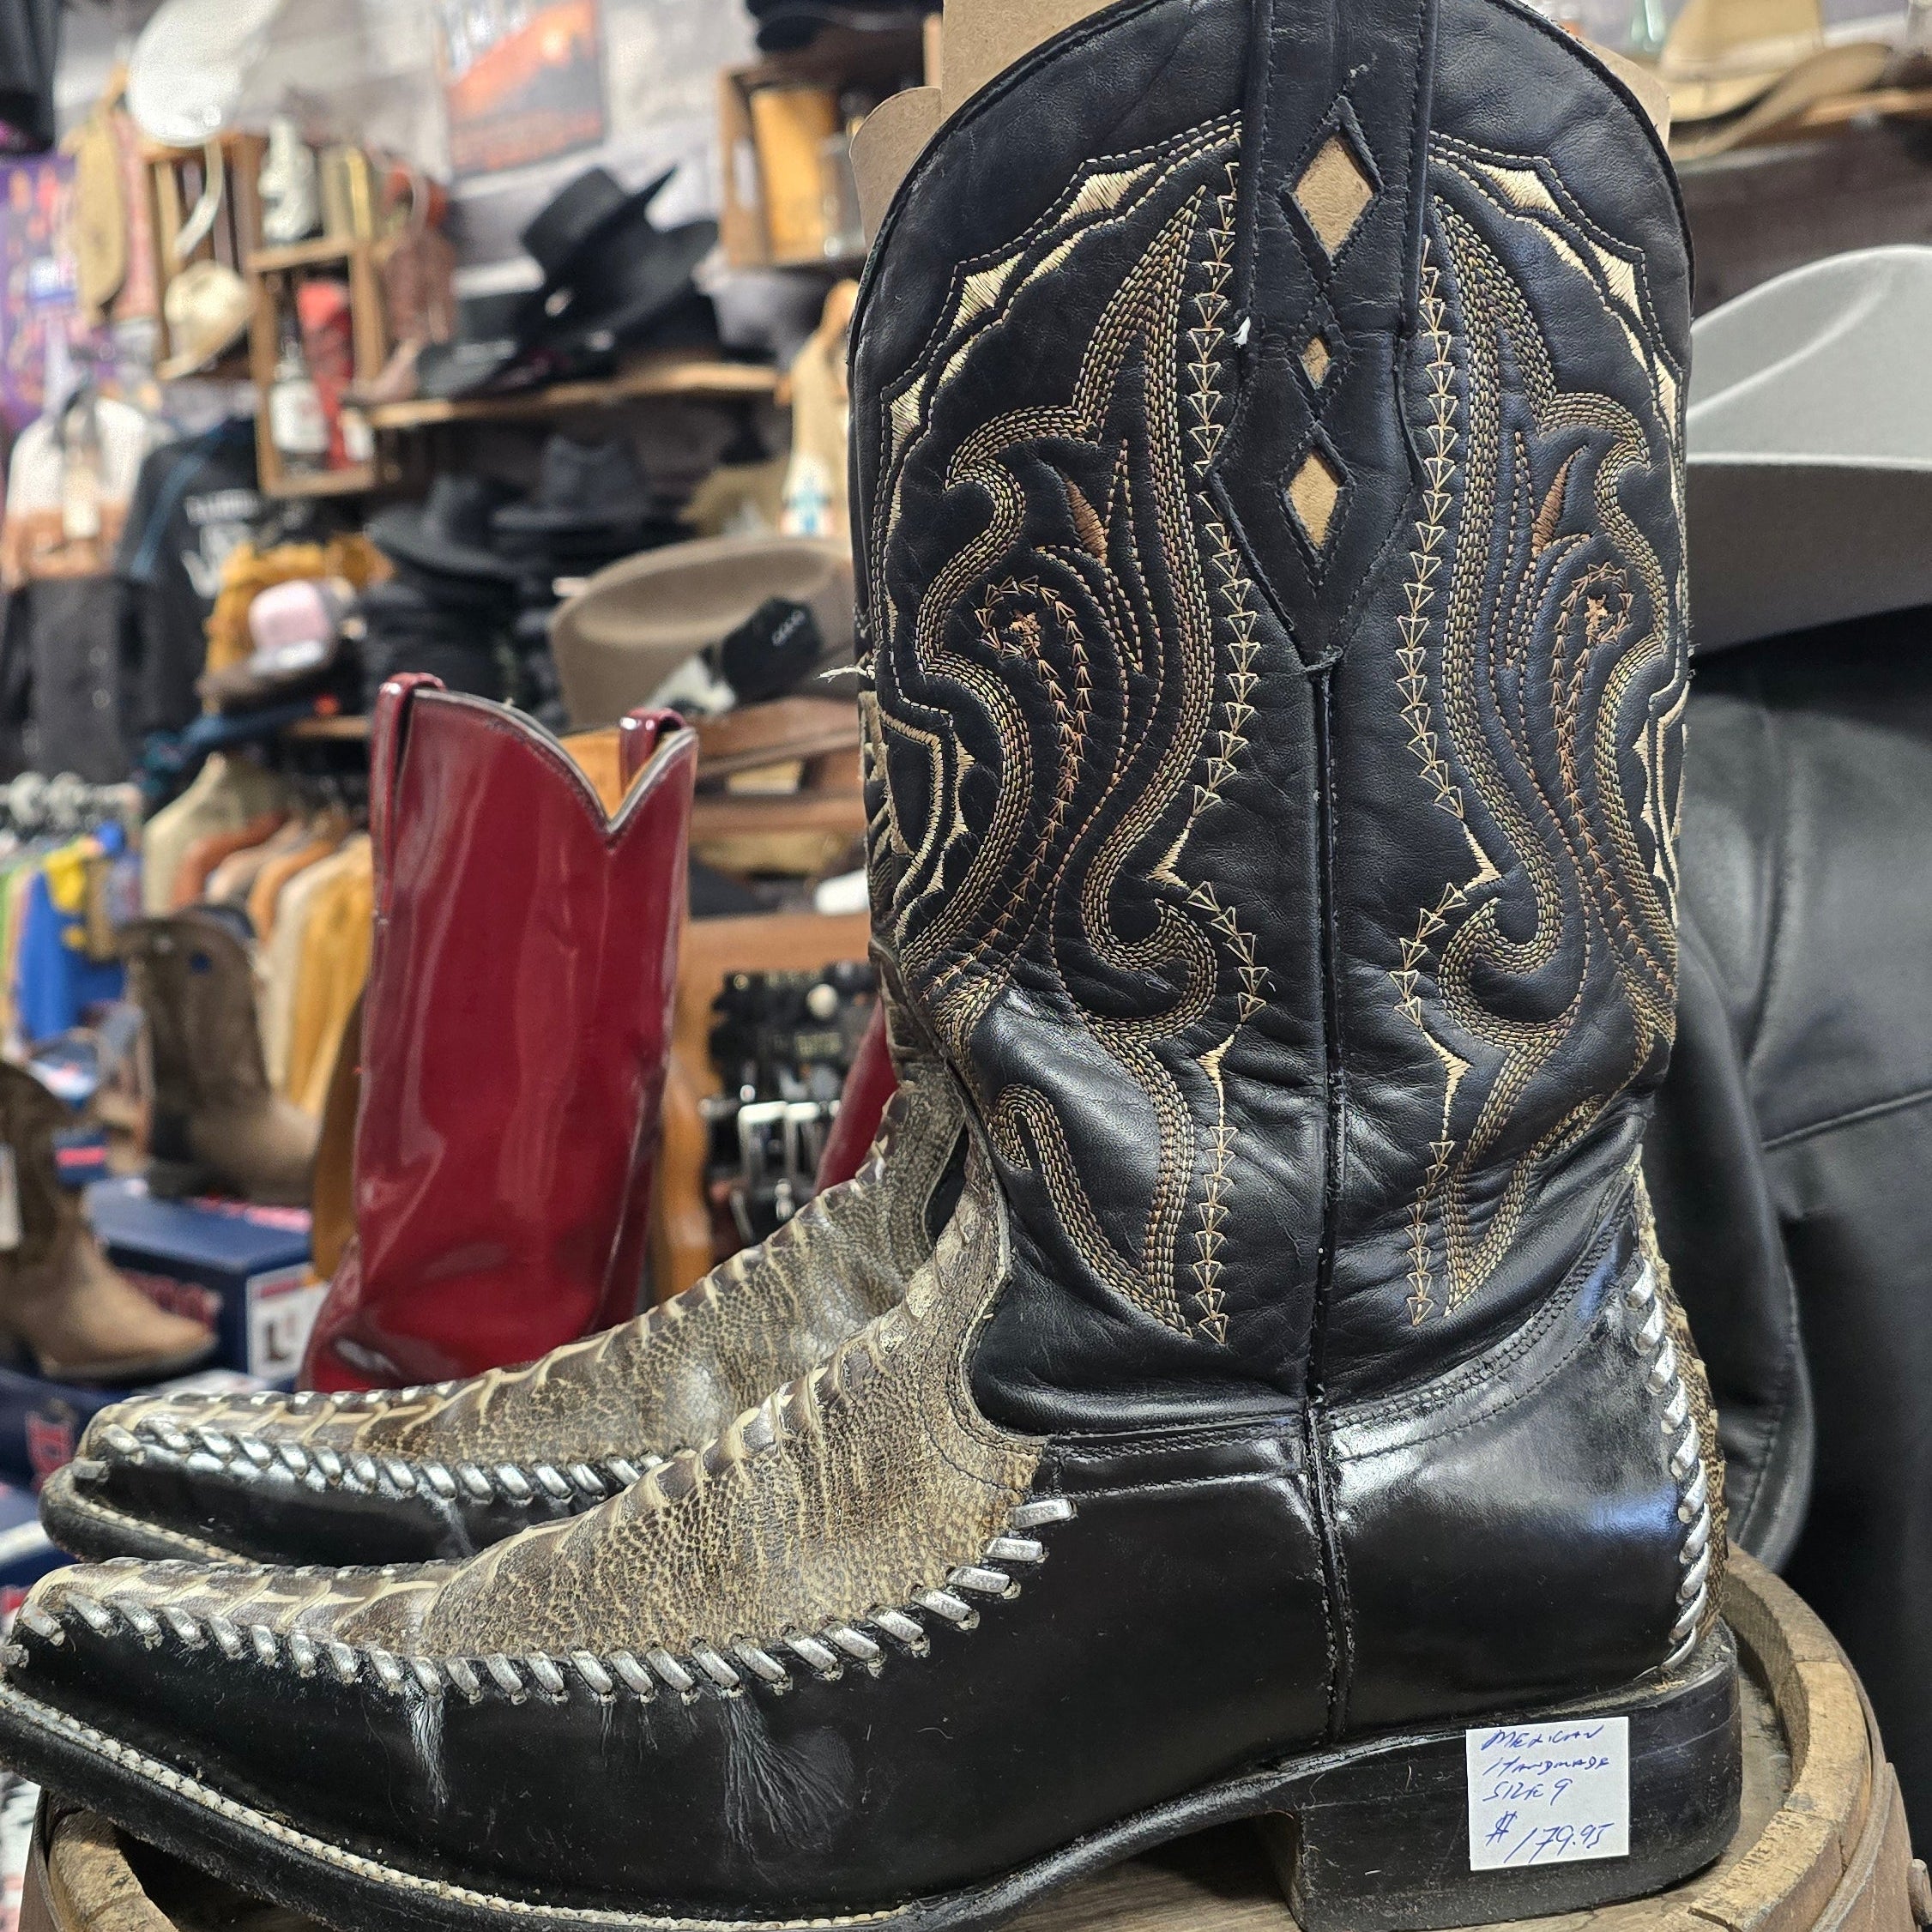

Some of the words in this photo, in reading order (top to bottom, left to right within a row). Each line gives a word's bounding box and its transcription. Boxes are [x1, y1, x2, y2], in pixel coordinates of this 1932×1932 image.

[1481, 1725, 1604, 1751] MEXICAN
[1482, 1781, 1544, 1802] SIZE
[1550, 1778, 1573, 1806] 9
